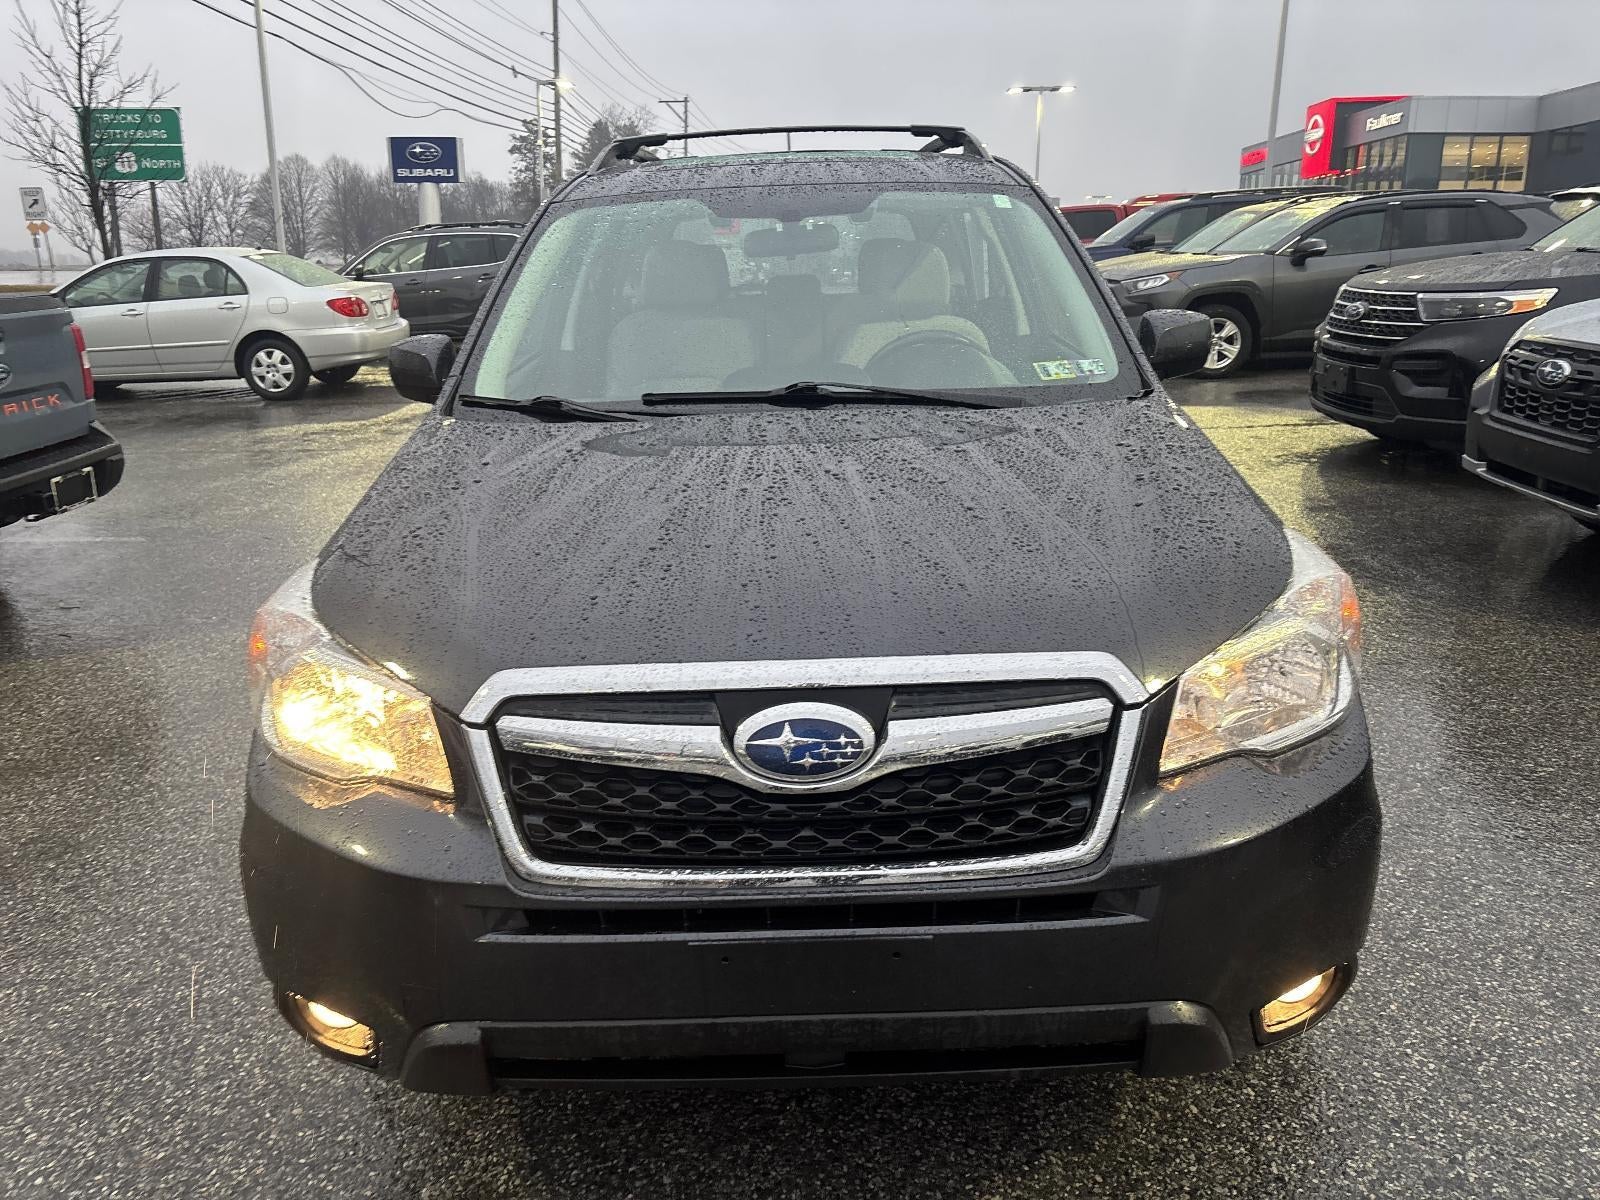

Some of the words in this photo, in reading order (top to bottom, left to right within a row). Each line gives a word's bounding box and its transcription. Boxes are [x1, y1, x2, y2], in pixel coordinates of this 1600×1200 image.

[95, 114, 141, 123] TRUCKS
[147, 114, 161, 123] TO
[94, 129, 168, 139] GETTYSBURG
[396, 168, 455, 177] SUBARU
